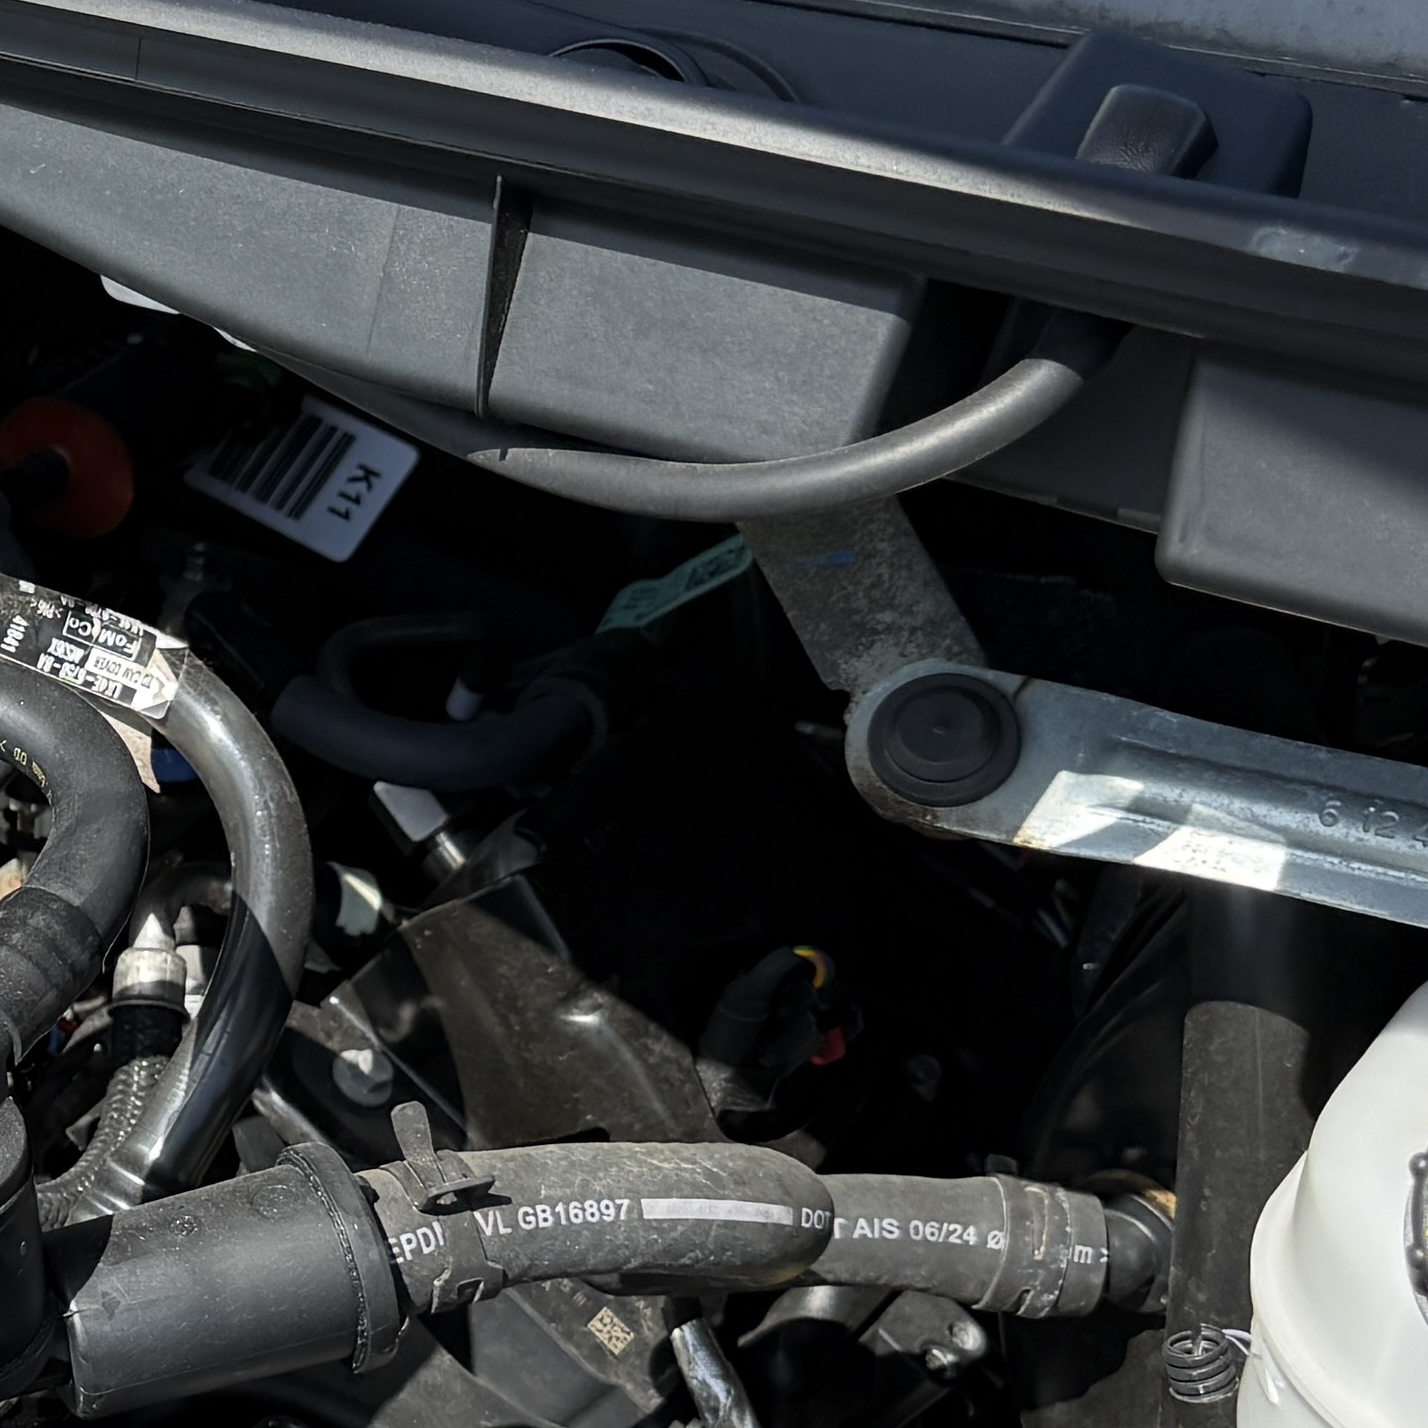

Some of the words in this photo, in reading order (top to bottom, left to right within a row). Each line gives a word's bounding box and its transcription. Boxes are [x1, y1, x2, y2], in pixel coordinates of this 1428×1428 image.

[326, 462, 382, 522] K11
[69, 617, 138, 655] FoMCo
[13, 746, 28, 766] OD
[473, 1209, 513, 1237] VL
[517, 1197, 631, 1232] GB16897
[852, 1218, 901, 1241] AIS
[908, 1218, 977, 1244] 06/24
